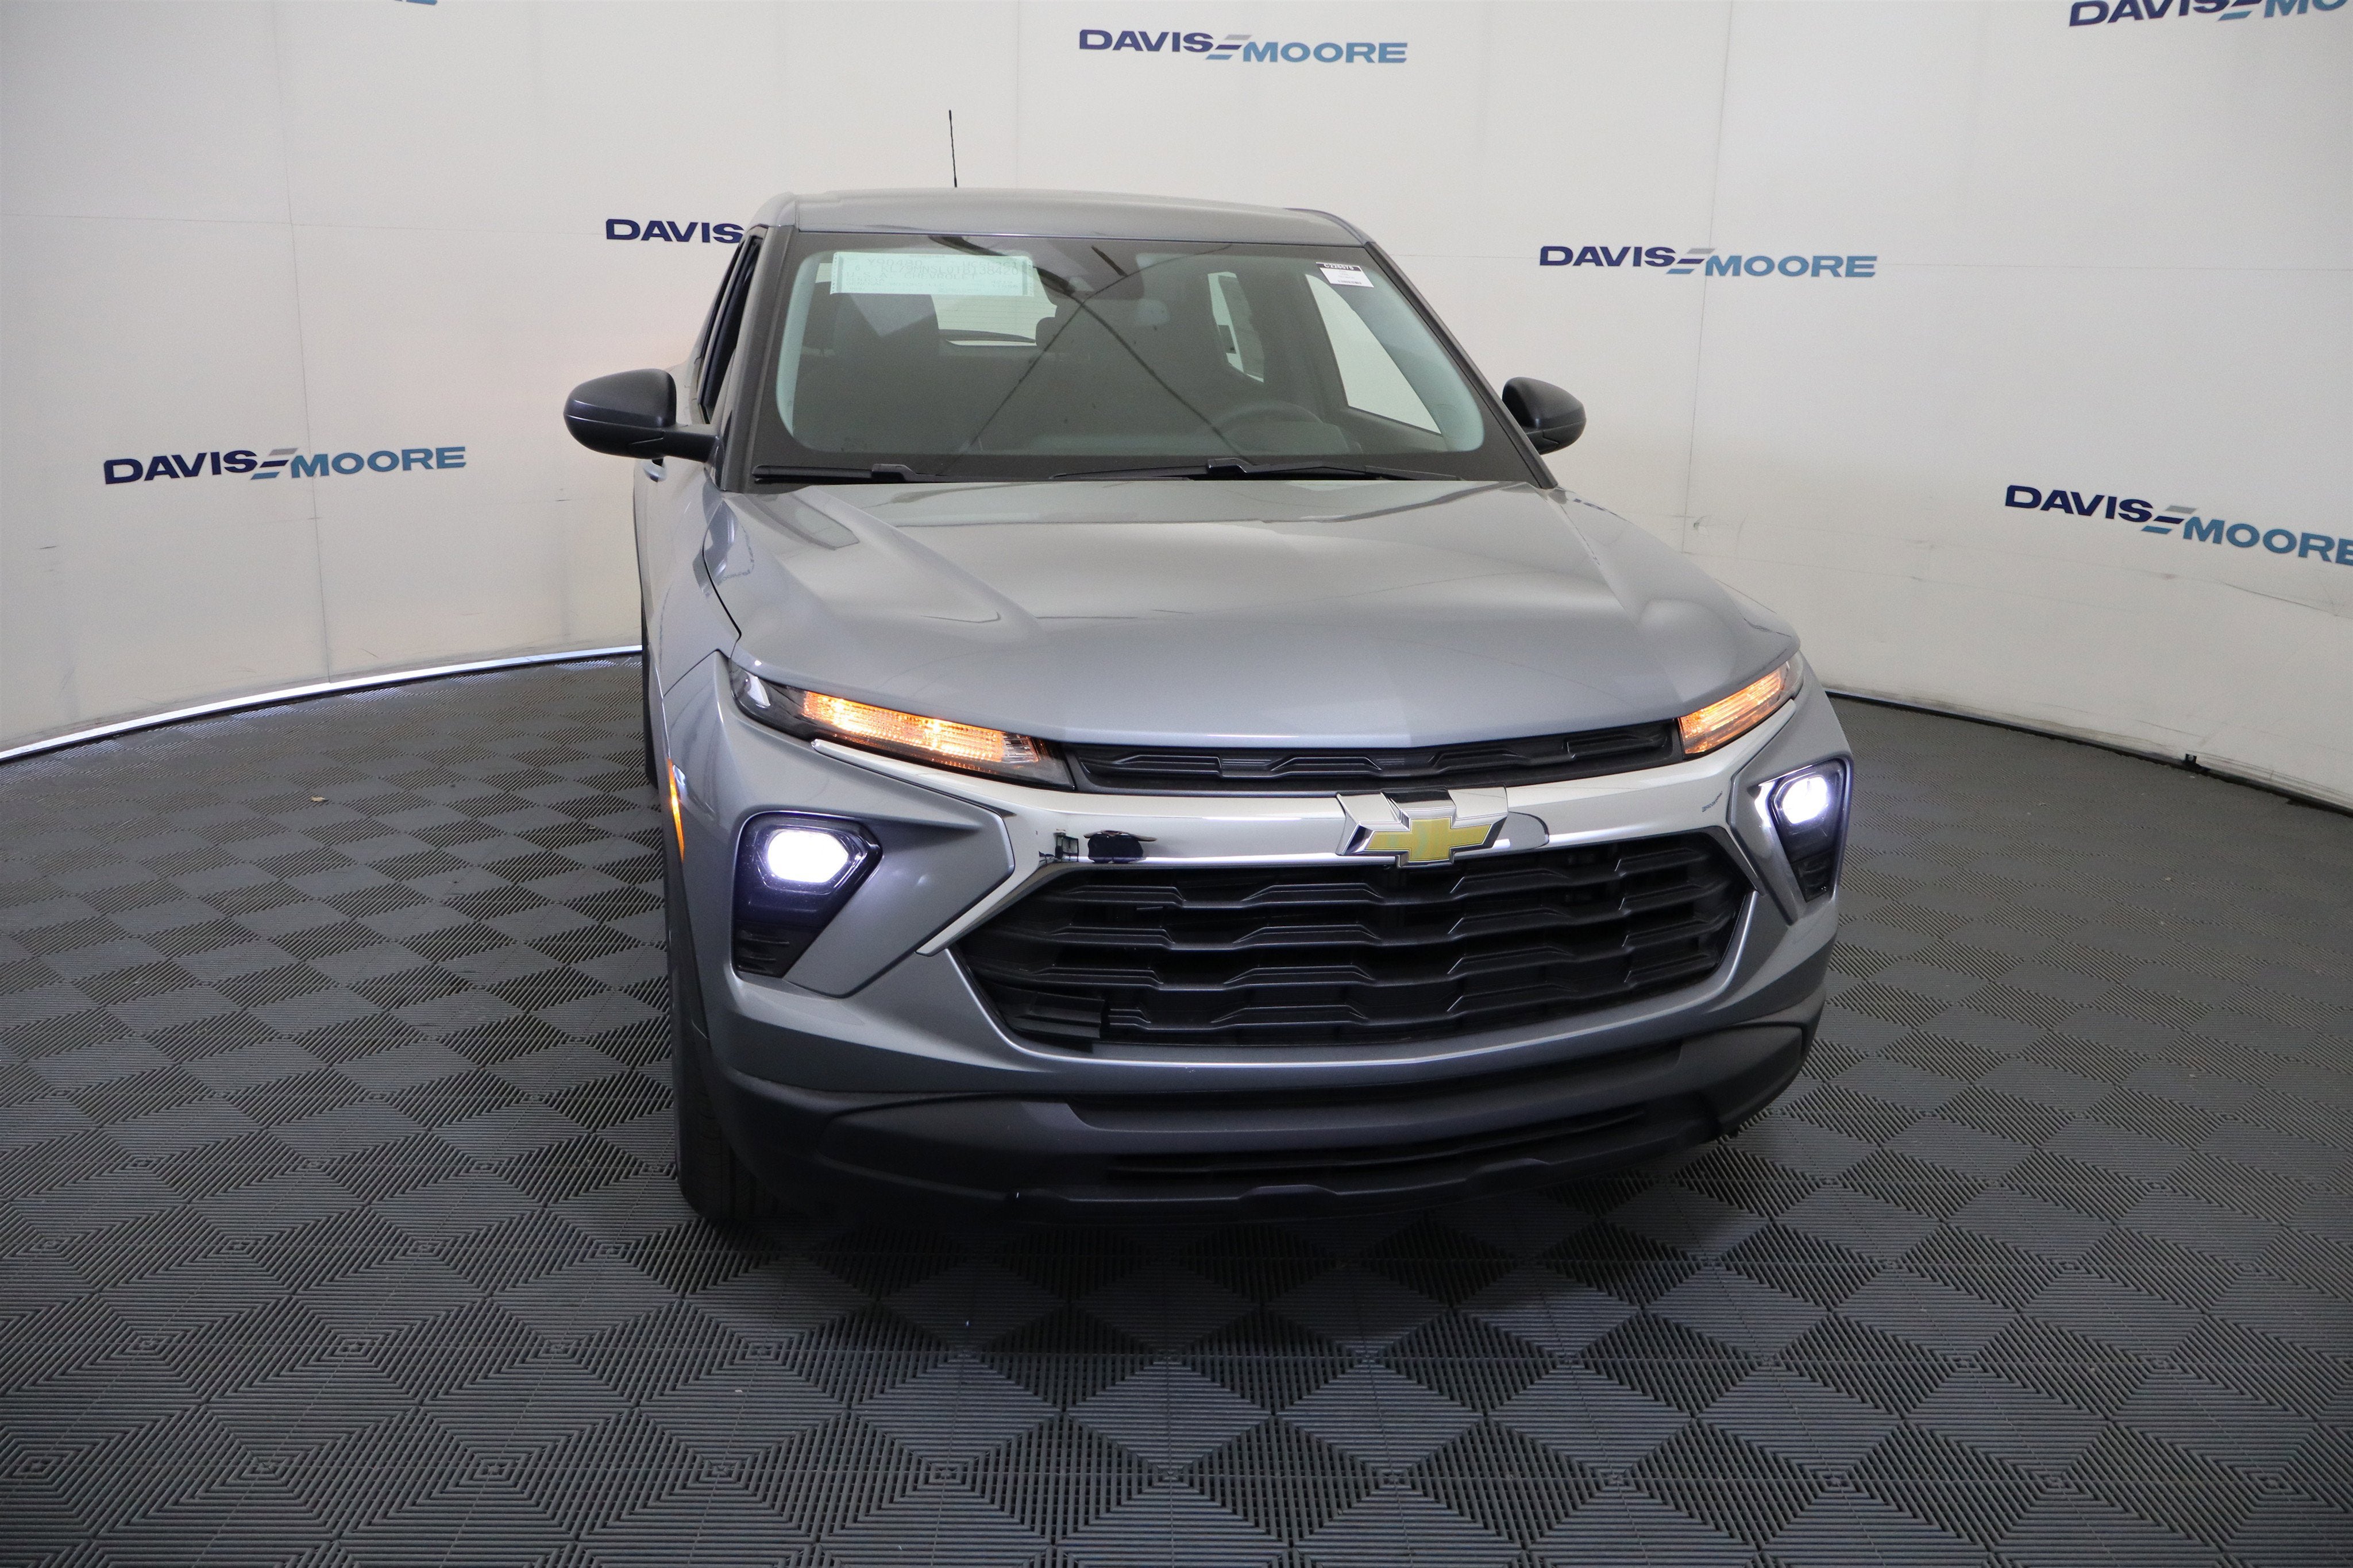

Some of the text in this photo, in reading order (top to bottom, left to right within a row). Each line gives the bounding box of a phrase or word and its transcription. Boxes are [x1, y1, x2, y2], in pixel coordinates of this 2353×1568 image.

[1079, 29, 1408, 64] DAVIS MOORE
[605, 218, 746, 244] DAVIS
[1539, 245, 1877, 278] DAVIS MOORE
[103, 446, 466, 485] DAVIS MOORE
[2004, 485, 2154, 523] DAVIS
